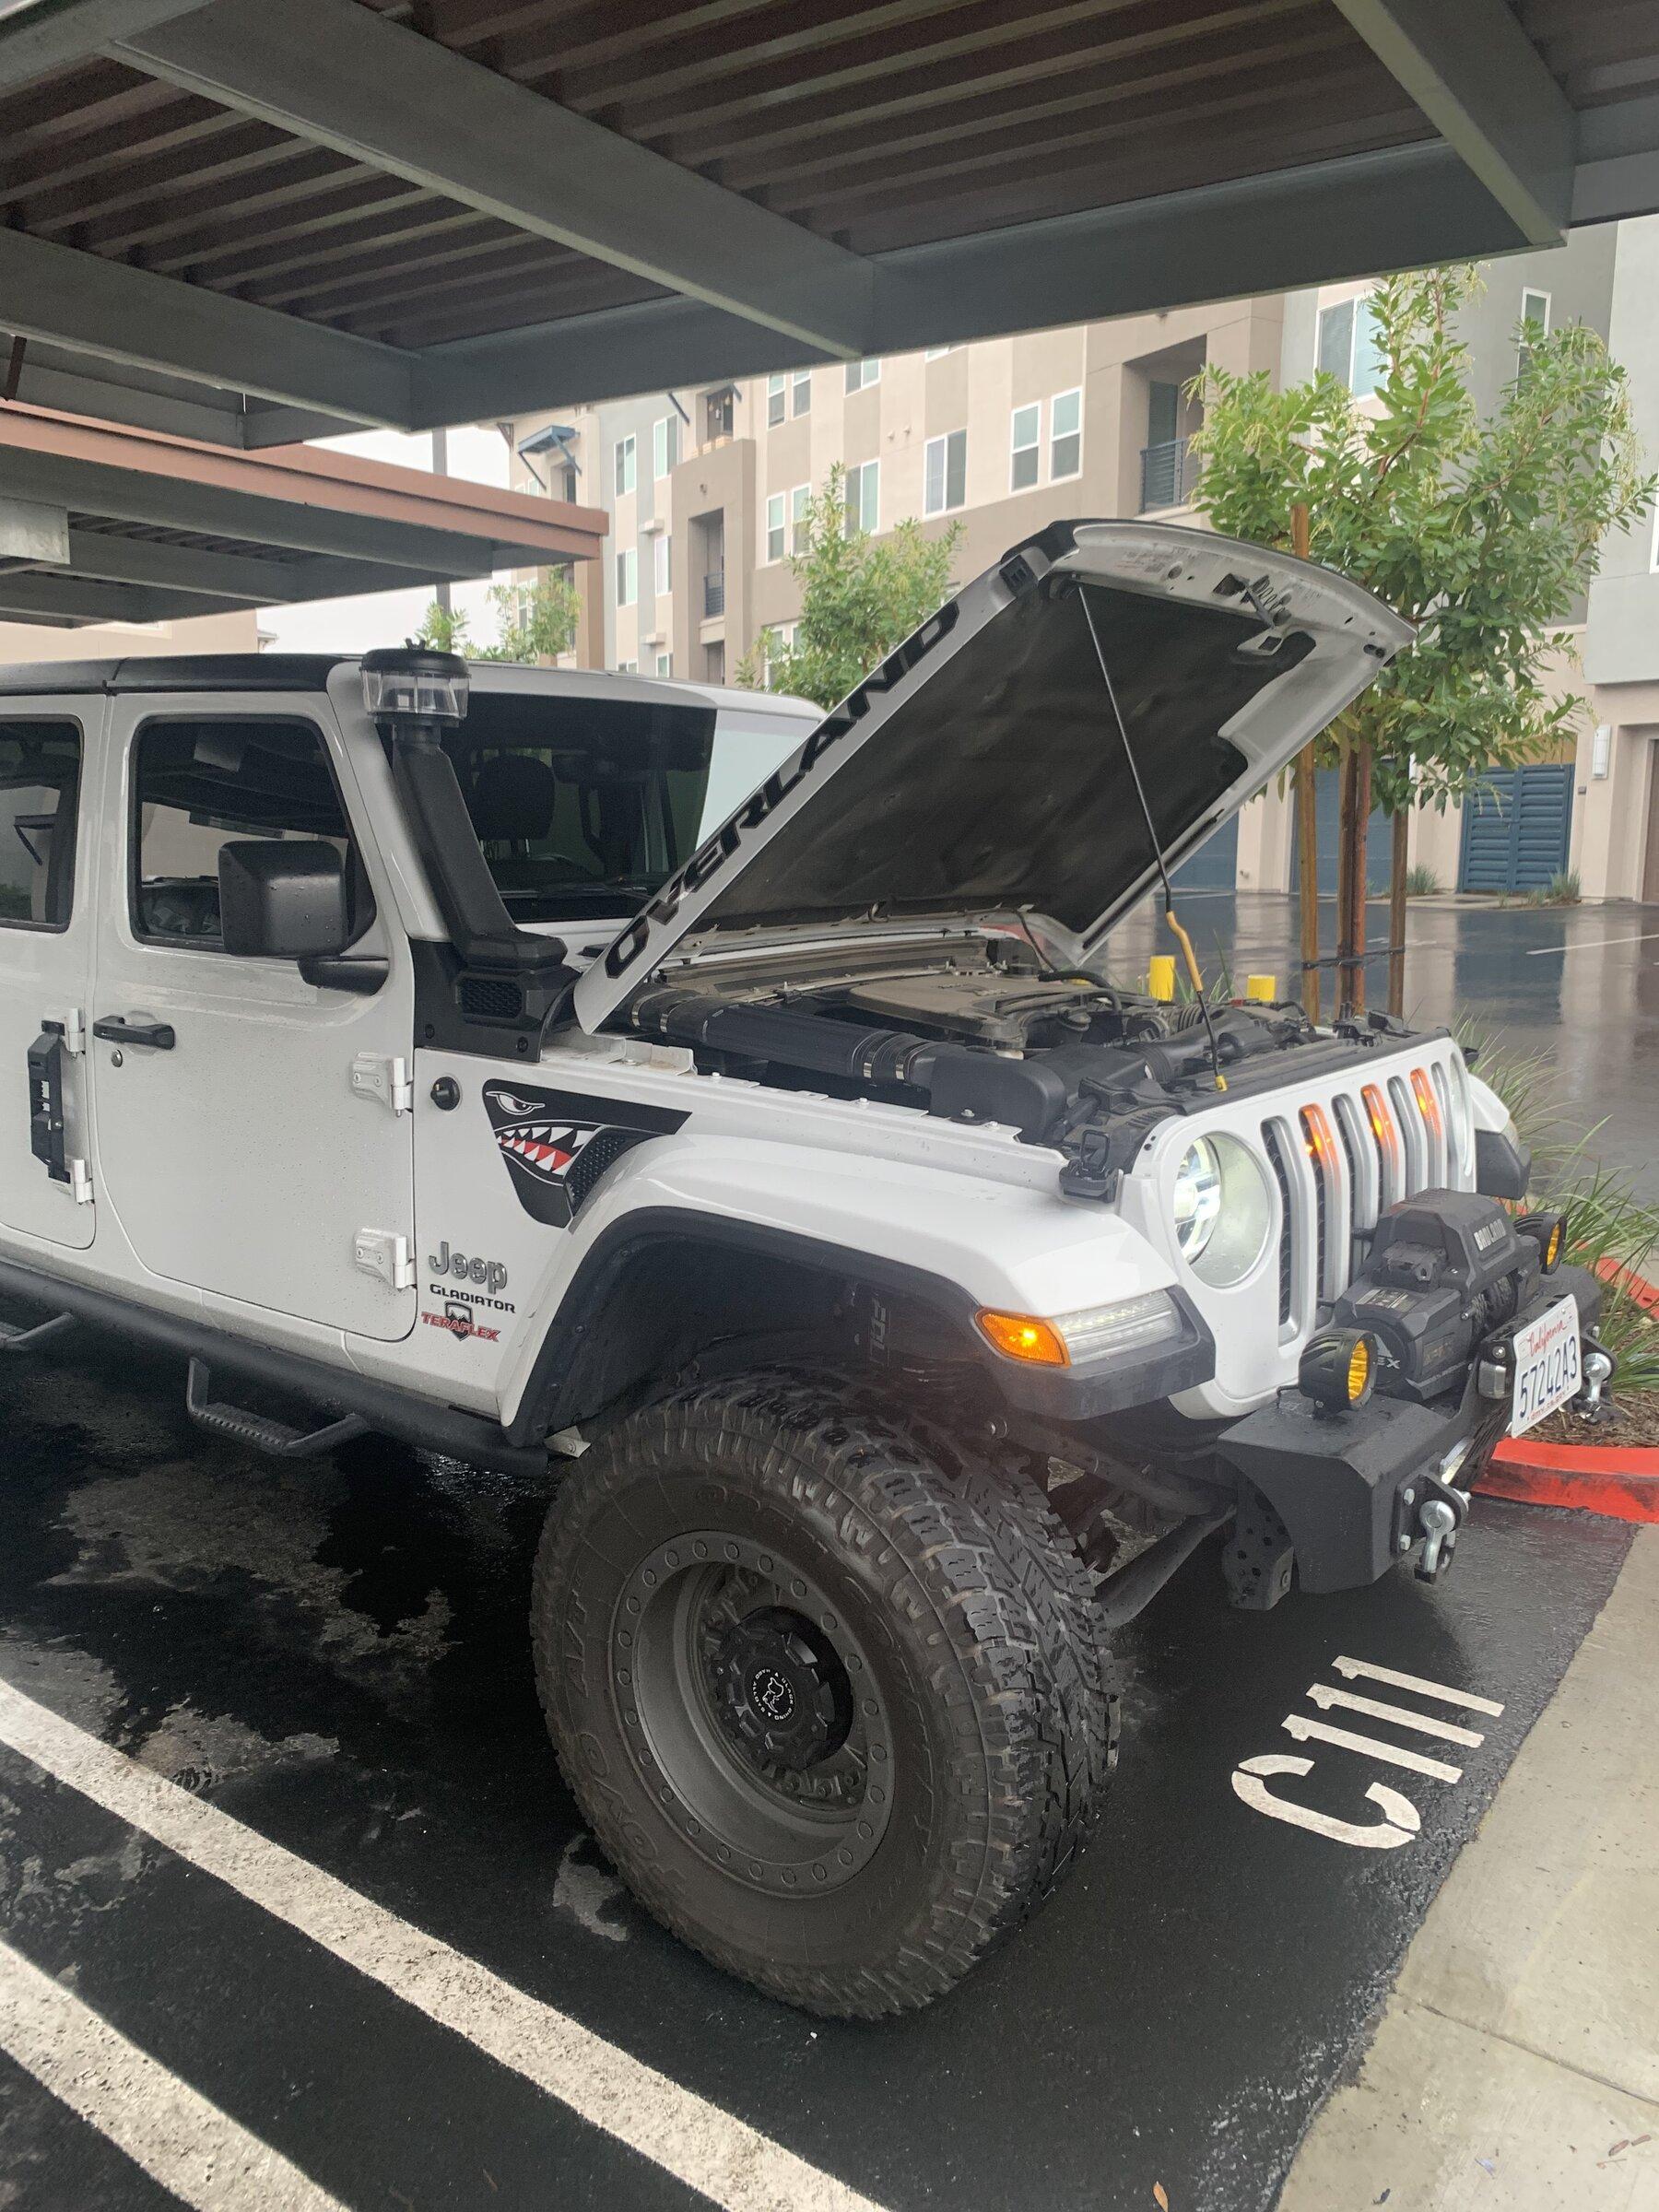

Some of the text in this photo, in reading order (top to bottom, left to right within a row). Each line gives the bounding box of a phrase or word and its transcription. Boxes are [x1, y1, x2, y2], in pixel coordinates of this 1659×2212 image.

[605, 601, 959, 979] OVERLAND
[429, 1241, 507, 1295] Jeep
[429, 1283, 516, 1313] GLADIATOR
[421, 1311, 501, 1343] TERAFLEX
[1527, 1320, 1569, 1359] California
[1519, 1335, 1579, 1419] 57242A3
[1230, 1655, 1506, 1850] C111
